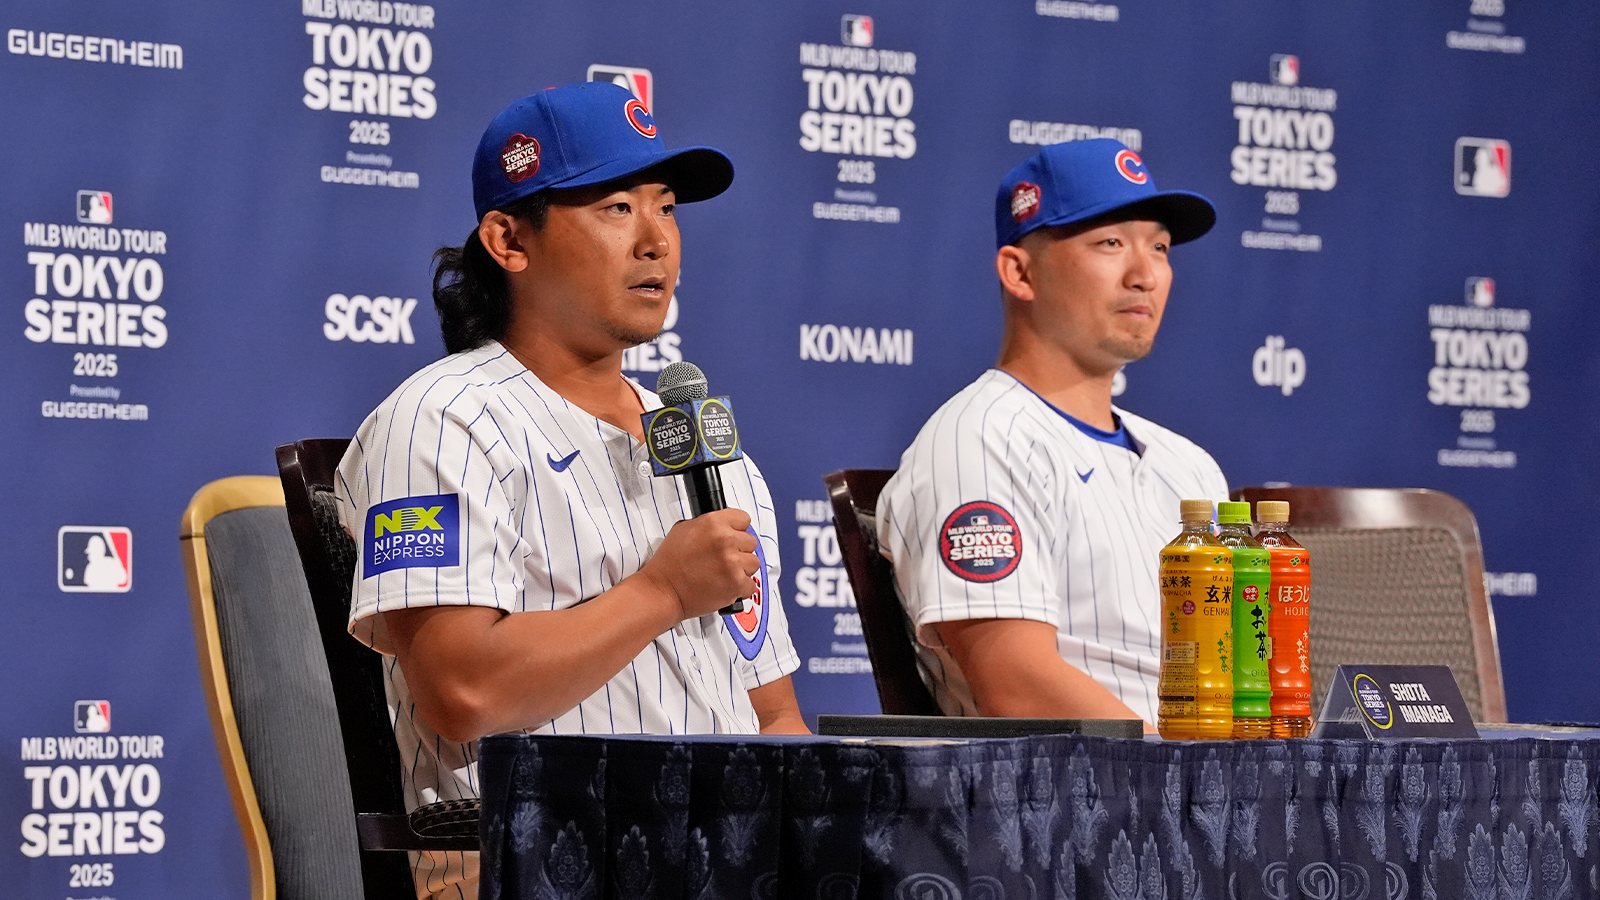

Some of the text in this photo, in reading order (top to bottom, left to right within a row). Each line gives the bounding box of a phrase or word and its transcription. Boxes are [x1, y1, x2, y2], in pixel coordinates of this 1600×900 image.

[302, 0, 435, 29] MLB WORLD TOUR
[8, 29, 183, 69] GUGGENHEIM
[305, 21, 432, 74] TOKYO
[302, 66, 438, 120] SERIES
[802, 68, 914, 117] TOKYO
[349, 120, 390, 146] 2025
[800, 110, 916, 159] SERIES
[1234, 106, 1334, 151] TOKYO
[505, 147, 534, 164] TOKYO
[506, 154, 538, 172] SERIES
[1230, 145, 1337, 191] SERIES
[321, 165, 420, 189] GUGGENHEIM
[838, 160, 875, 184] 2025
[24, 222, 167, 254] MLB WORLD TOUR
[27, 252, 164, 302] TOKYO
[24, 298, 168, 348] SERIES
[323, 294, 418, 344] SCSK
[800, 324, 914, 366] KONAMI
[1430, 328, 1528, 370] TOKYO
[73, 352, 118, 377] 2025
[1252, 335, 1306, 396] dip
[1427, 366, 1530, 409] SERIES
[42, 400, 148, 420] GUGGENHEIM
[655, 424, 688, 441] TOKYO
[704, 418, 729, 428] TOKYO
[706, 427, 732, 436] SERIES
[656, 433, 691, 450] SERIES
[948, 524, 1012, 536] MLB WORLD TOUR
[950, 532, 1012, 548] TOKYO
[374, 533, 444, 553] NIPPON
[950, 545, 1016, 560] SERIES
[374, 546, 444, 566] EXPRESS
[973, 558, 994, 566] 2025
[795, 567, 857, 608] SER
[1390, 683, 1432, 702] SHOTA
[1399, 705, 1454, 723] IMANAGA
[21, 735, 164, 760] MLB WORLD TOUR
[24, 764, 161, 810] TOKYO
[20, 810, 165, 858] SERIES
[69, 863, 114, 888] 2025
